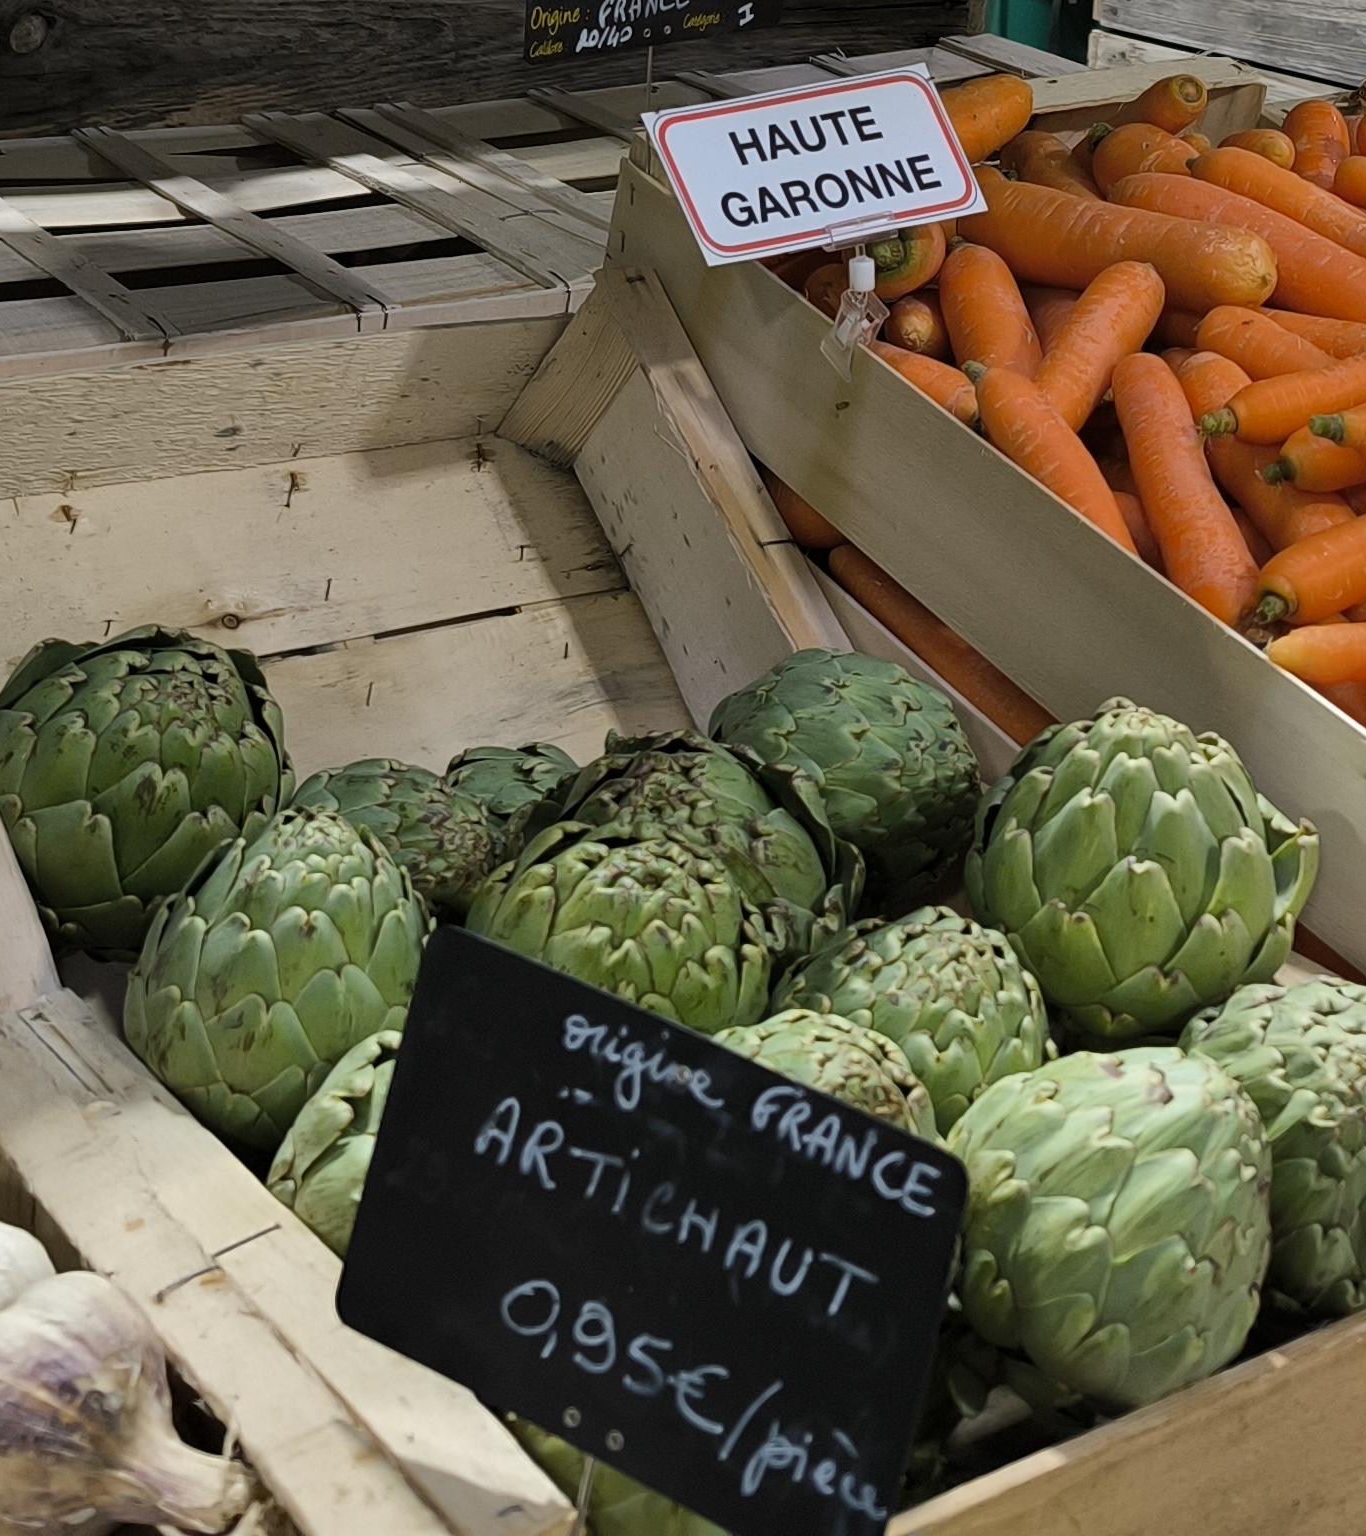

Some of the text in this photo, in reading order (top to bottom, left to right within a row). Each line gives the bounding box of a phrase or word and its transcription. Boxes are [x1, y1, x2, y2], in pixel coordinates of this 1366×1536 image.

[530, 4, 581, 35] Origine
[728, 105, 884, 166] HAUTE
[720, 154, 942, 228] GARONNE
[564, 1013, 942, 1217] origine FRANCE
